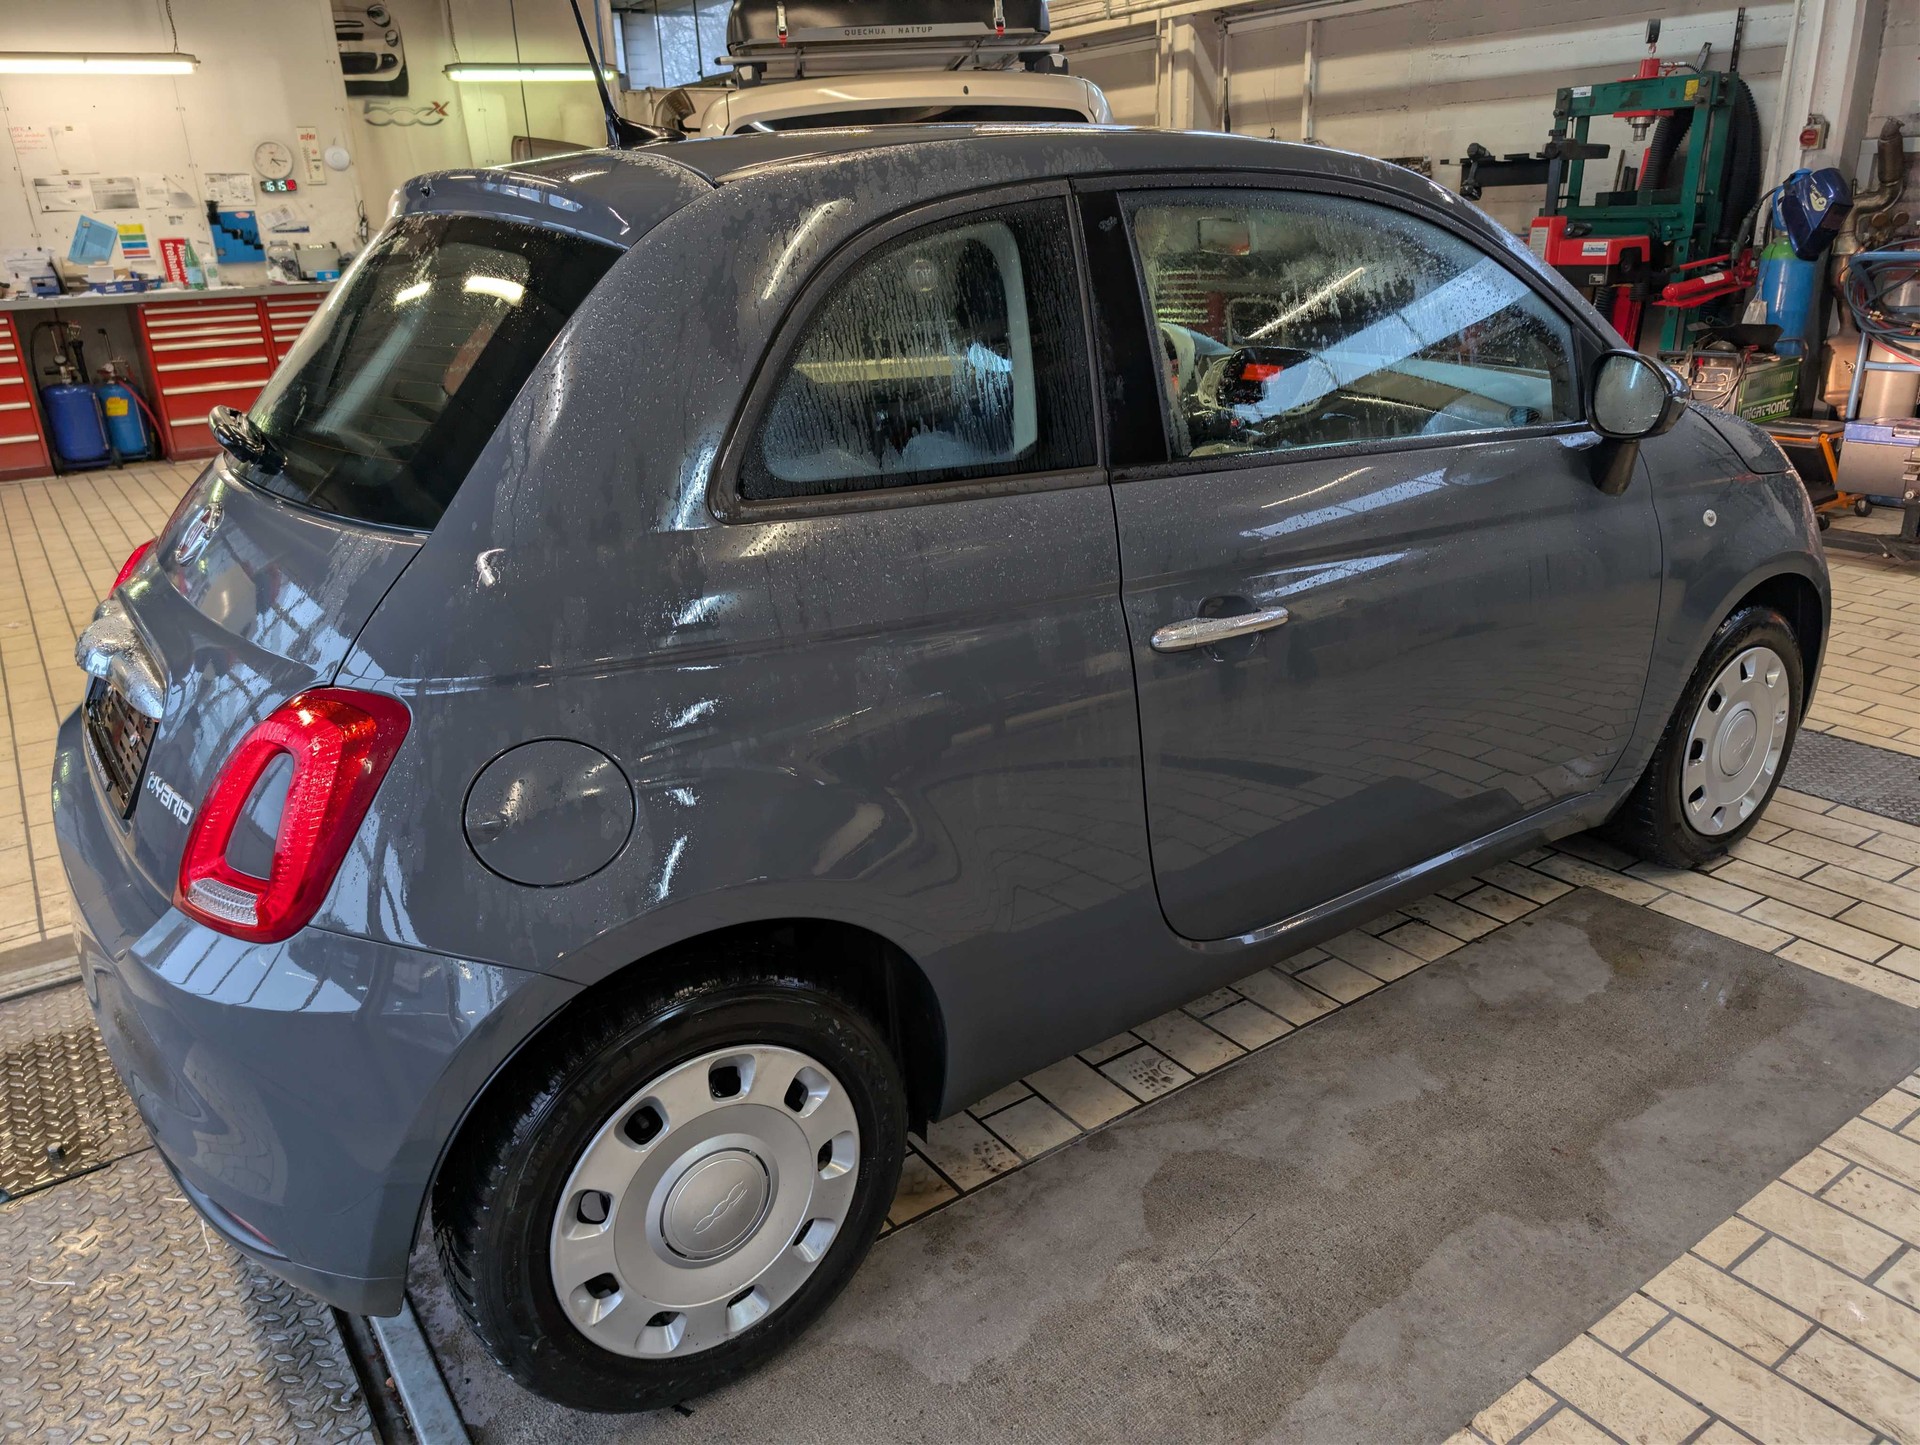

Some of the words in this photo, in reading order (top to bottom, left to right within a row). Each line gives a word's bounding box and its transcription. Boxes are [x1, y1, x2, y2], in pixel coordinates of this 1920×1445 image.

[844, 28, 886, 36] QUECHUA
[165, 242, 181, 281] freihalte
[147, 771, 194, 825] HYBRID
